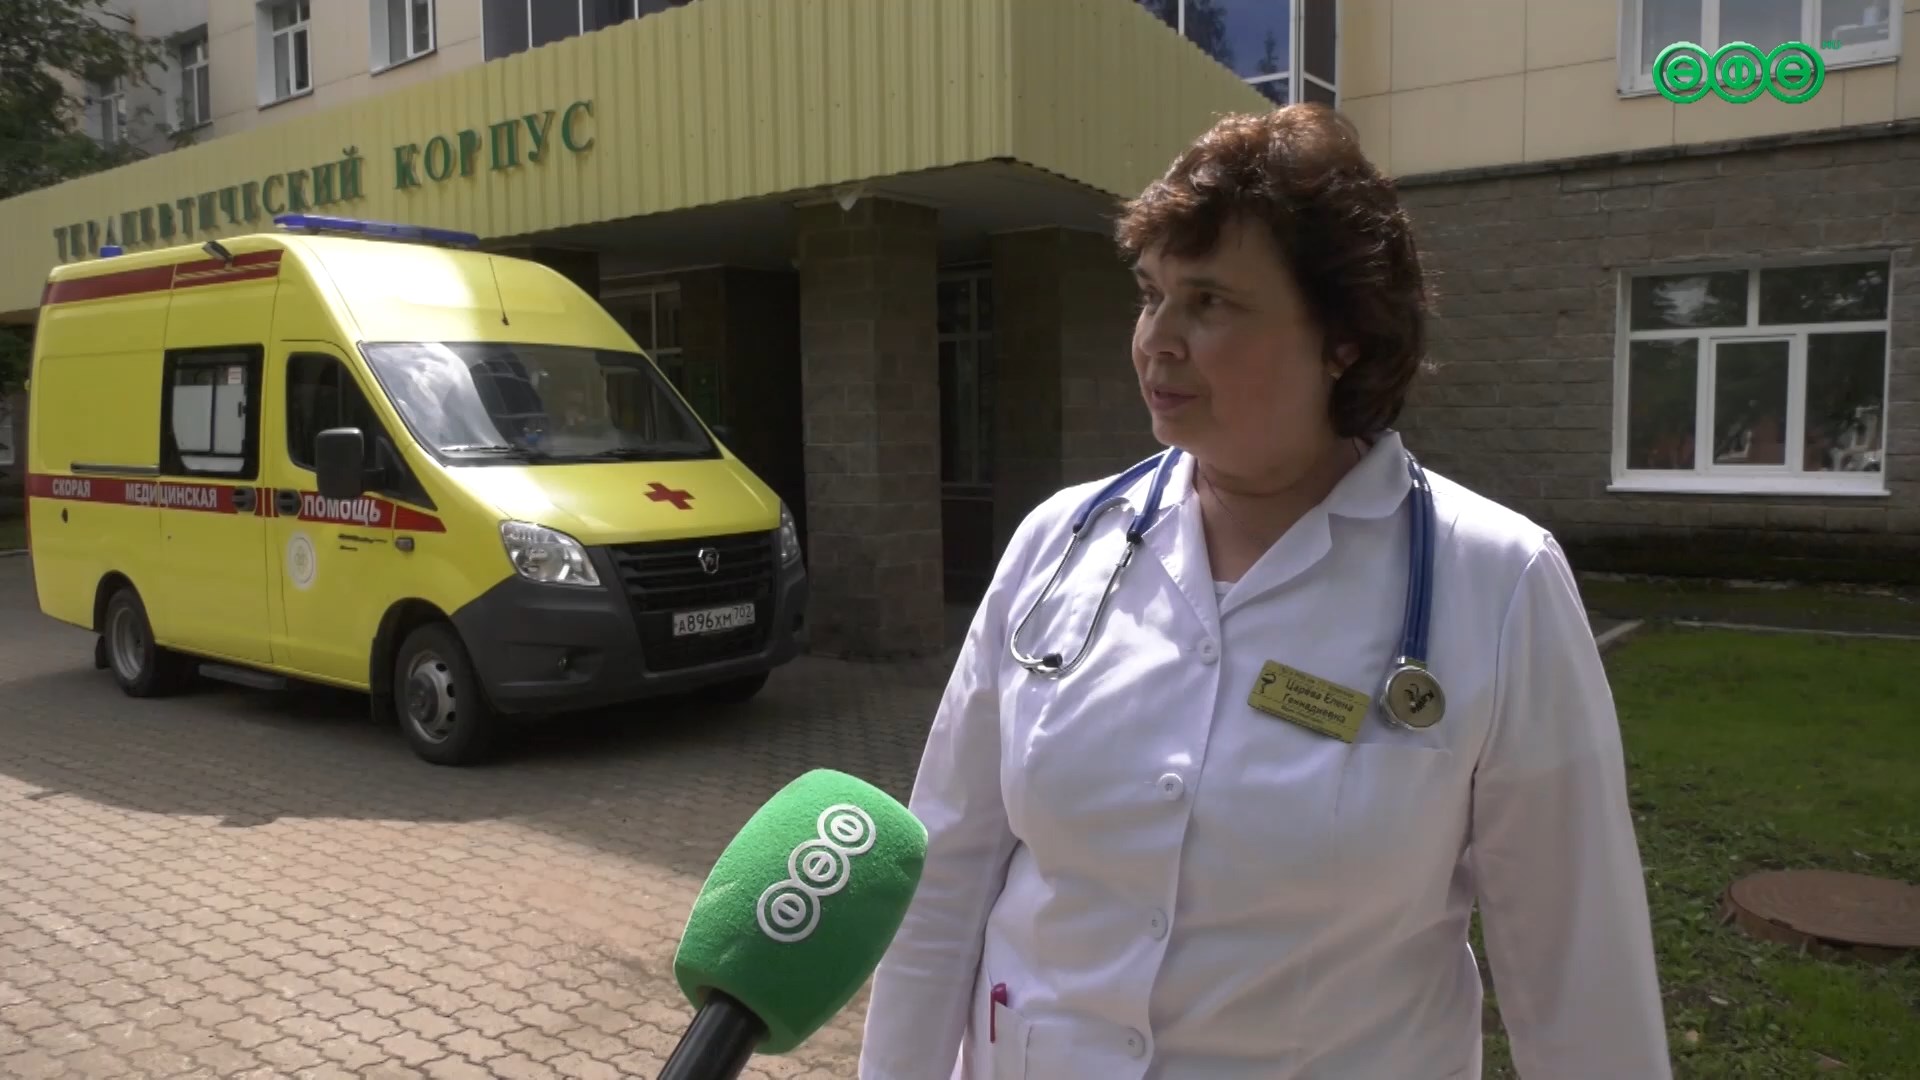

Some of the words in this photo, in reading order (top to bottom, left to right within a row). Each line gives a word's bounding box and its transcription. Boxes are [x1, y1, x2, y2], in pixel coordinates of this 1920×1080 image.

[53, 145, 365, 263] ТЕРАПЕВТИЧЕСКИЙ
[394, 101, 595, 190] КОРПУС
[52, 479, 91, 498] СКОРАЯ
[125, 483, 217, 508] МЕДИЦИНСКАЯ
[304, 495, 381, 526] ПОМОЩЬ
